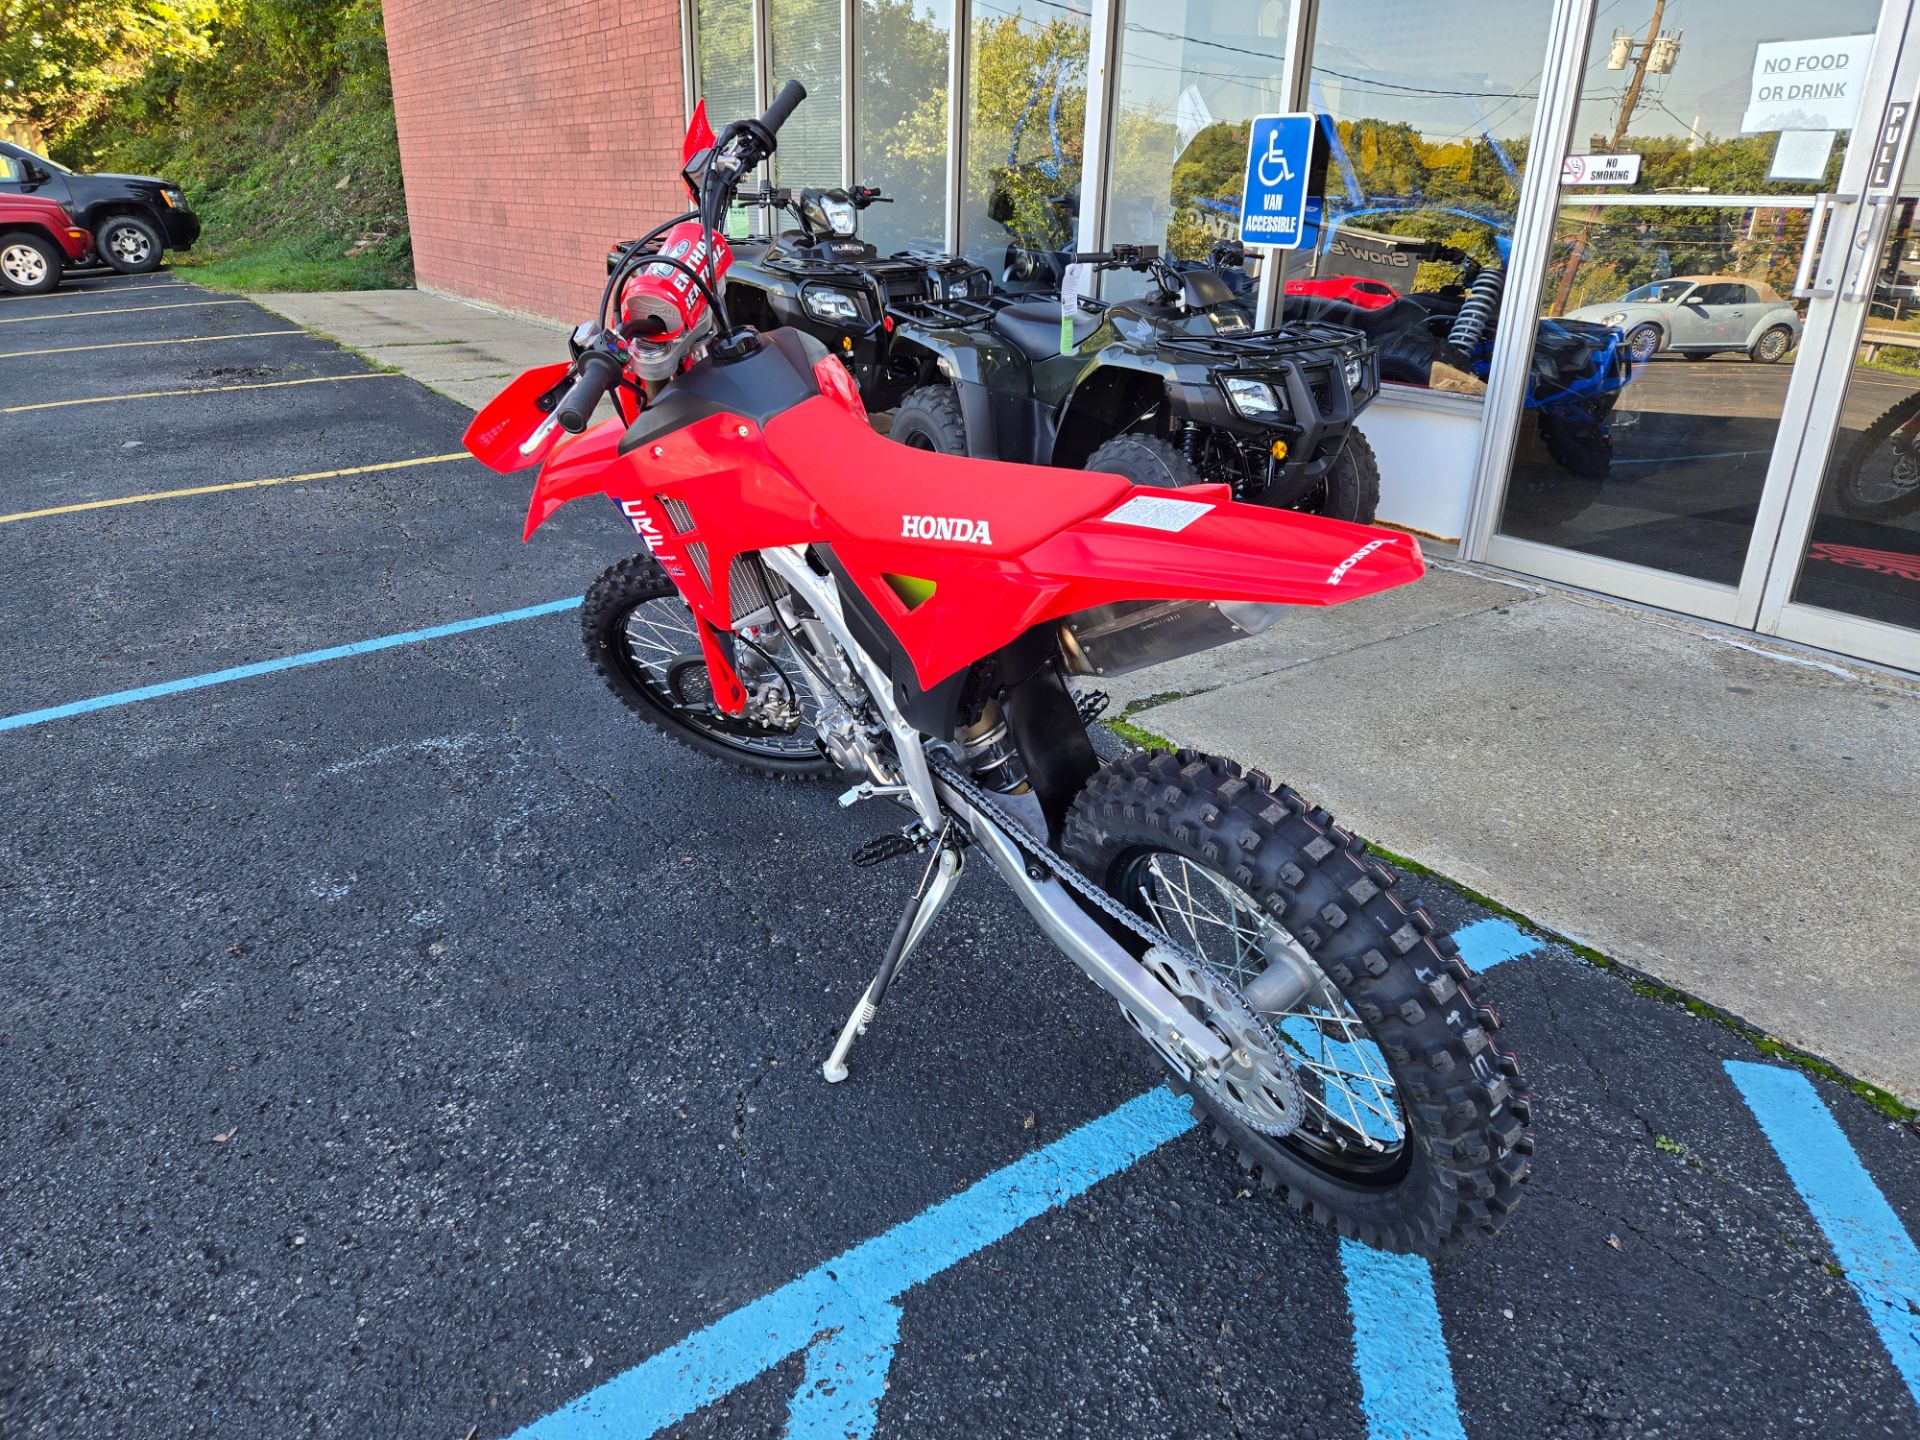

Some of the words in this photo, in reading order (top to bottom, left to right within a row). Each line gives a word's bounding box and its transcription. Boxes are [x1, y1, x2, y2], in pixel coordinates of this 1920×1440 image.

[1763, 57, 1792, 73] NO
[1795, 53, 1850, 71] FOOD
[1758, 85, 1784, 101] OR
[1787, 82, 1848, 99] DRINK
[1874, 106, 1905, 184] PULL
[1605, 158, 1618, 169] NO
[1590, 170, 1630, 181] SMOKING
[1263, 194, 1283, 211] VAN
[1245, 215, 1297, 233] ACCESSIBLE
[621, 499, 664, 552] CRF
[901, 515, 993, 546] HONDA
[1326, 538, 1398, 586] HONDA
